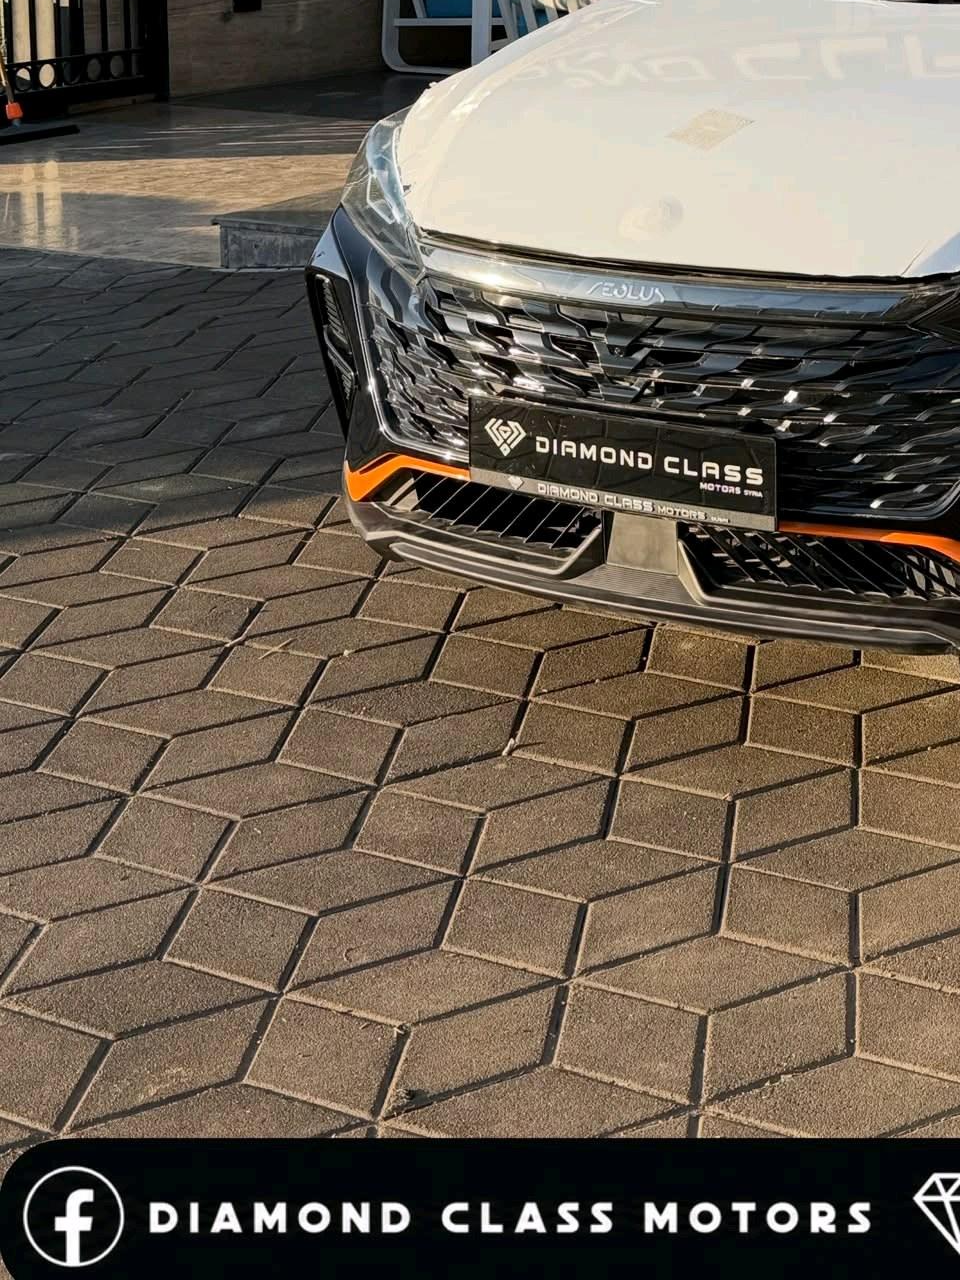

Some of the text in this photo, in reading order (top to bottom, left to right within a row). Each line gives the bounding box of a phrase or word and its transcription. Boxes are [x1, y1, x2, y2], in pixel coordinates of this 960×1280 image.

[535, 436, 764, 486] DIAMOND CLASS
[537, 483, 707, 520] DIAMOND CLASS MOTORS
[700, 481, 763, 498] MOTORS SYRIA
